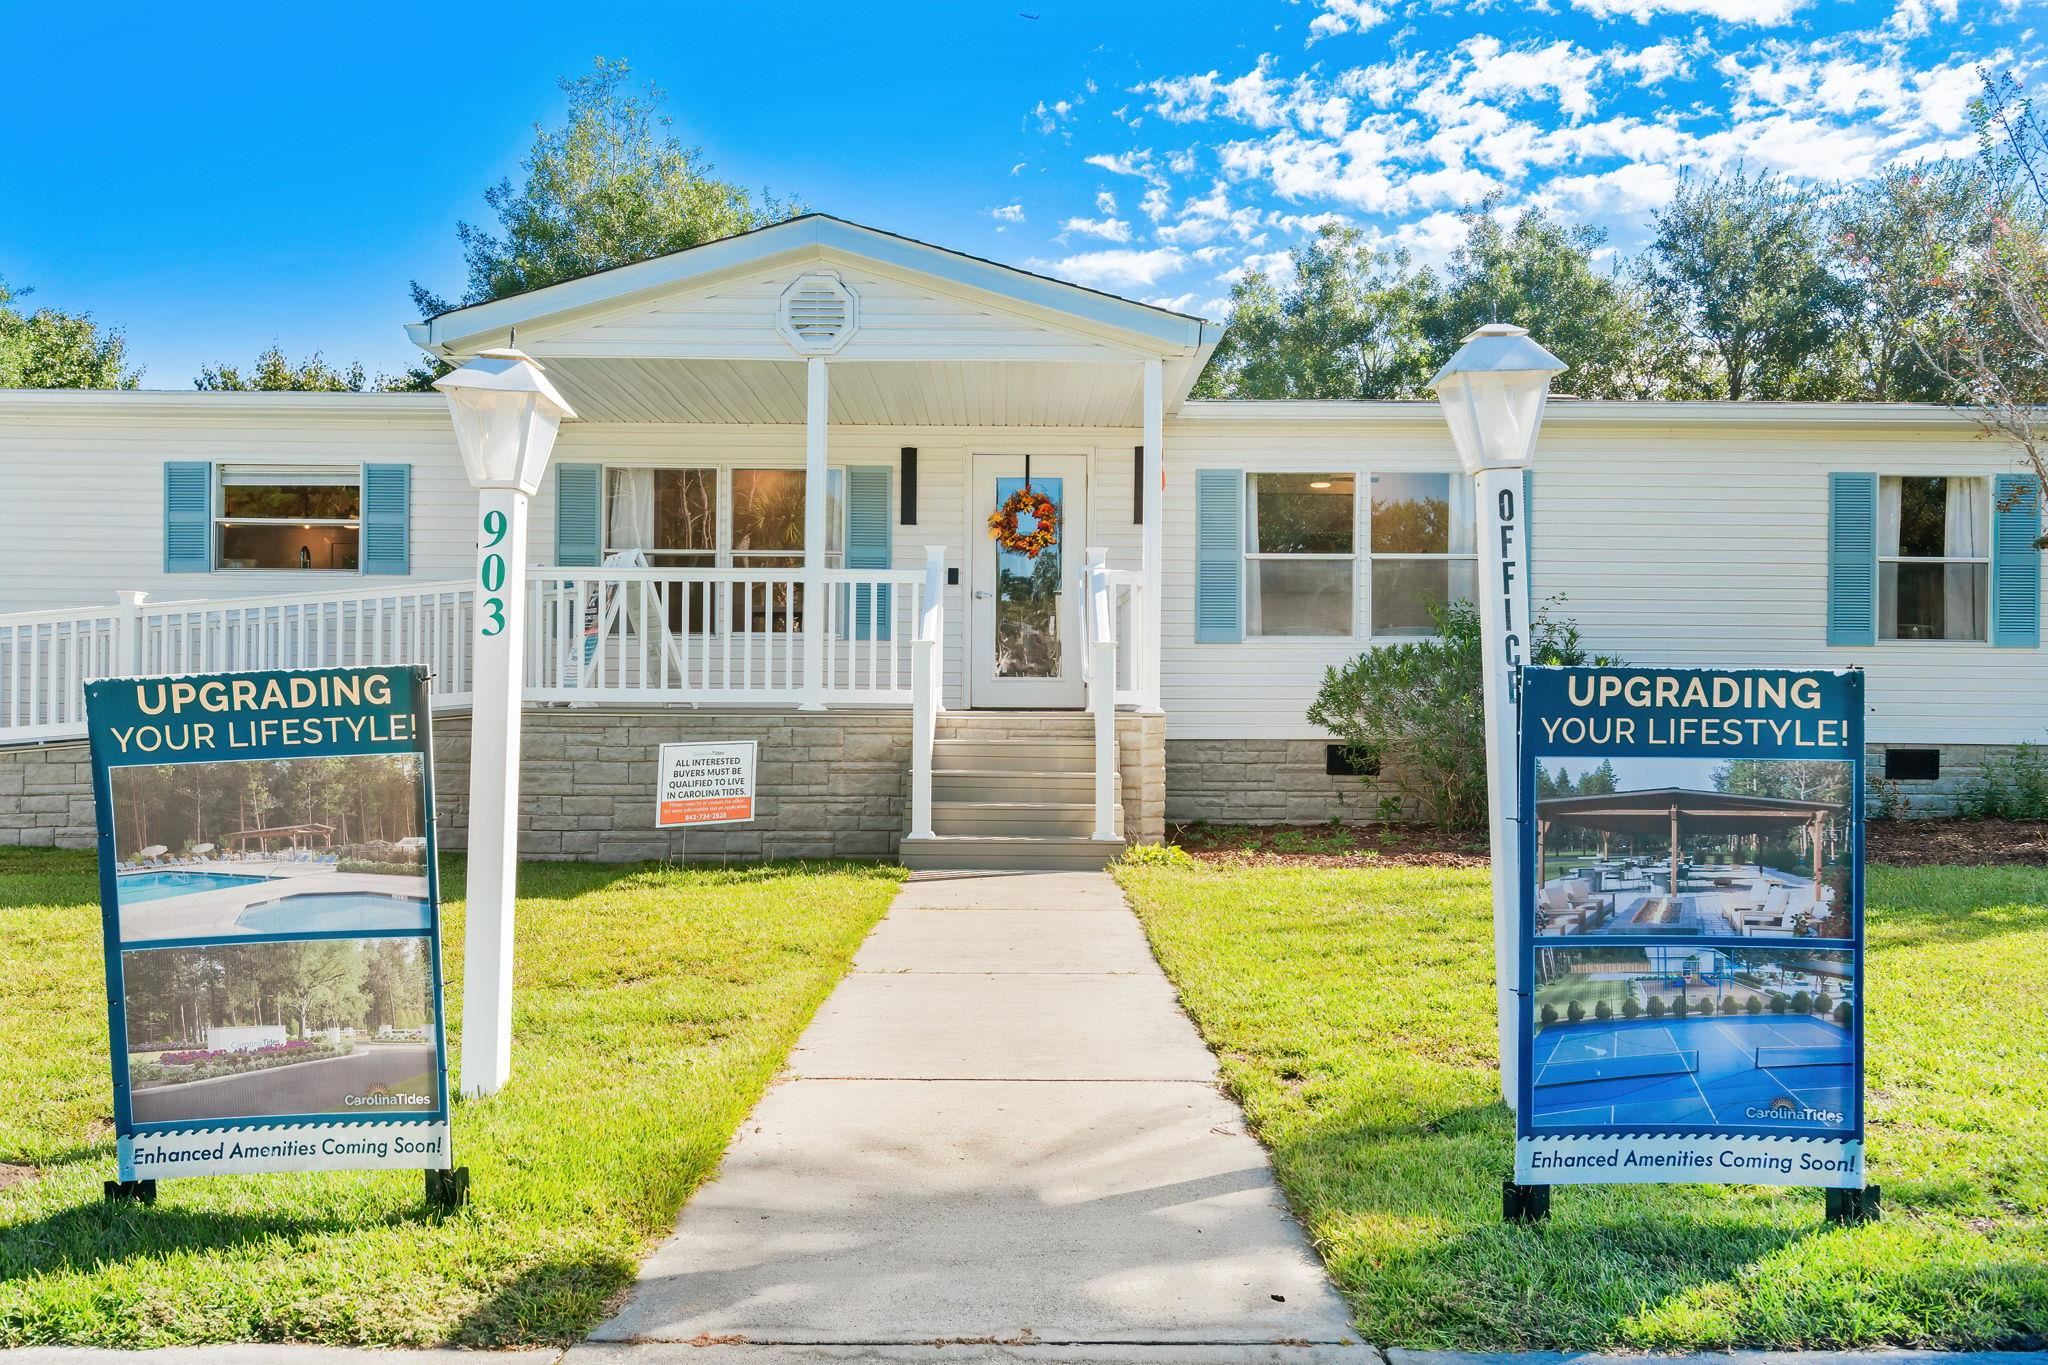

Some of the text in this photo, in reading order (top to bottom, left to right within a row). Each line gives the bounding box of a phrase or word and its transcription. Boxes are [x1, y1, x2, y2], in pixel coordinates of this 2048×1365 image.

[481, 510, 507, 636] 903
[136, 673, 392, 715] UPGRADING
[1568, 675, 1822, 709] UPGRADING
[110, 713, 417, 753] YOUR LIFESTYLE!
[1541, 717, 1848, 748] YOUR LIFESTYLE!
[673, 767, 742, 778] BUYERS MUST BE
[675, 757, 741, 768] ALL INTERESTED
[667, 787, 747, 799] IN CAROLINA TIDES.
[669, 777, 745, 789] QUALIFIED TO LIVE
[345, 1094, 430, 1106] CarolinaTides
[1746, 1106, 1844, 1122] CarolinaTides
[134, 1136, 442, 1165] Enhanced Amenities Coming Soon!
[1531, 1150, 1855, 1173] Enhanced Amenities Coming Soon!
